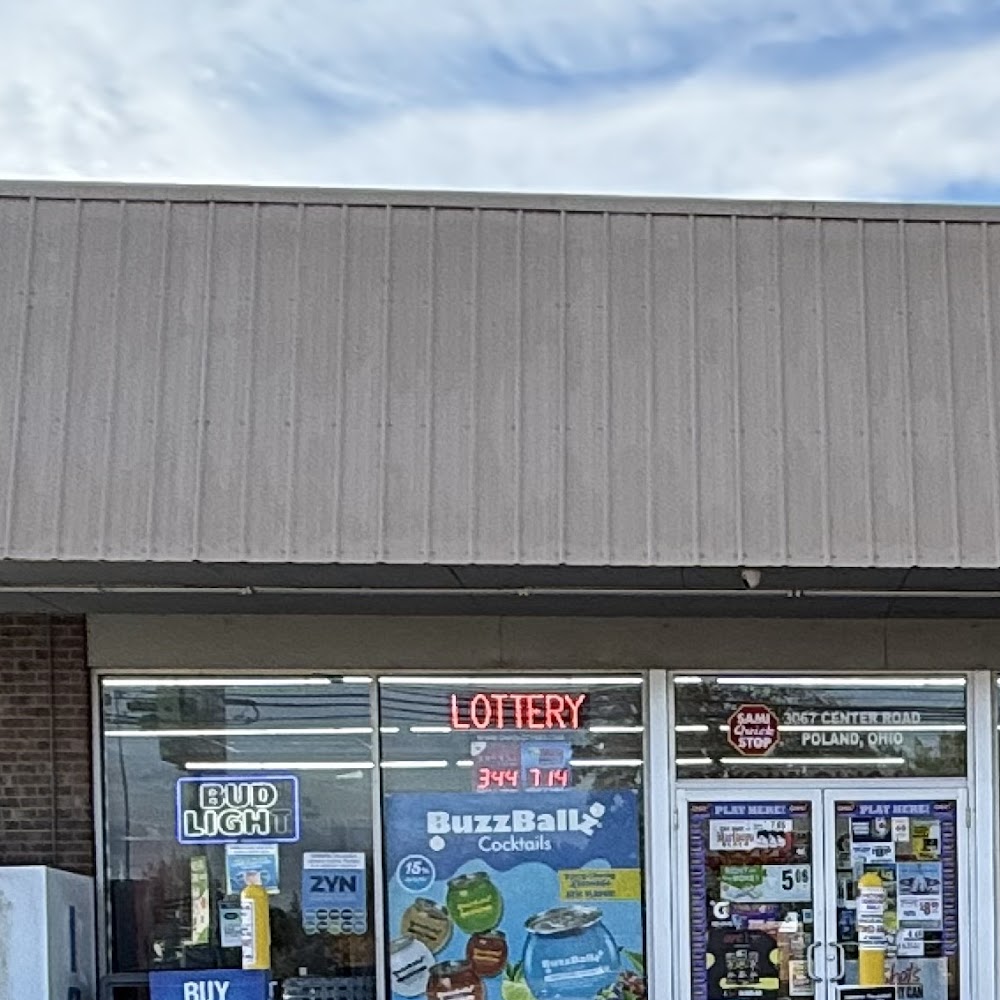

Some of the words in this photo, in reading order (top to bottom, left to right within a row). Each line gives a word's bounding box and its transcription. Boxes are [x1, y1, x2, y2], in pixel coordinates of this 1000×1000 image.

[451, 692, 586, 730] LOTTERY
[737, 712, 771, 724] SAMI
[784, 711, 816, 724] 3067
[821, 711, 881, 724] CENTER
[882, 711, 921, 724] ROAD
[738, 737, 772, 749] STOP
[802, 732, 864, 748] POLAND,
[868, 732, 903, 746] OHIO
[477, 767, 518, 789] 344
[200, 782, 279, 809] BUD
[184, 809, 291, 838] LIGHT
[478, 835, 552, 852] Cocktails
[310, 875, 357, 894] ZYN
